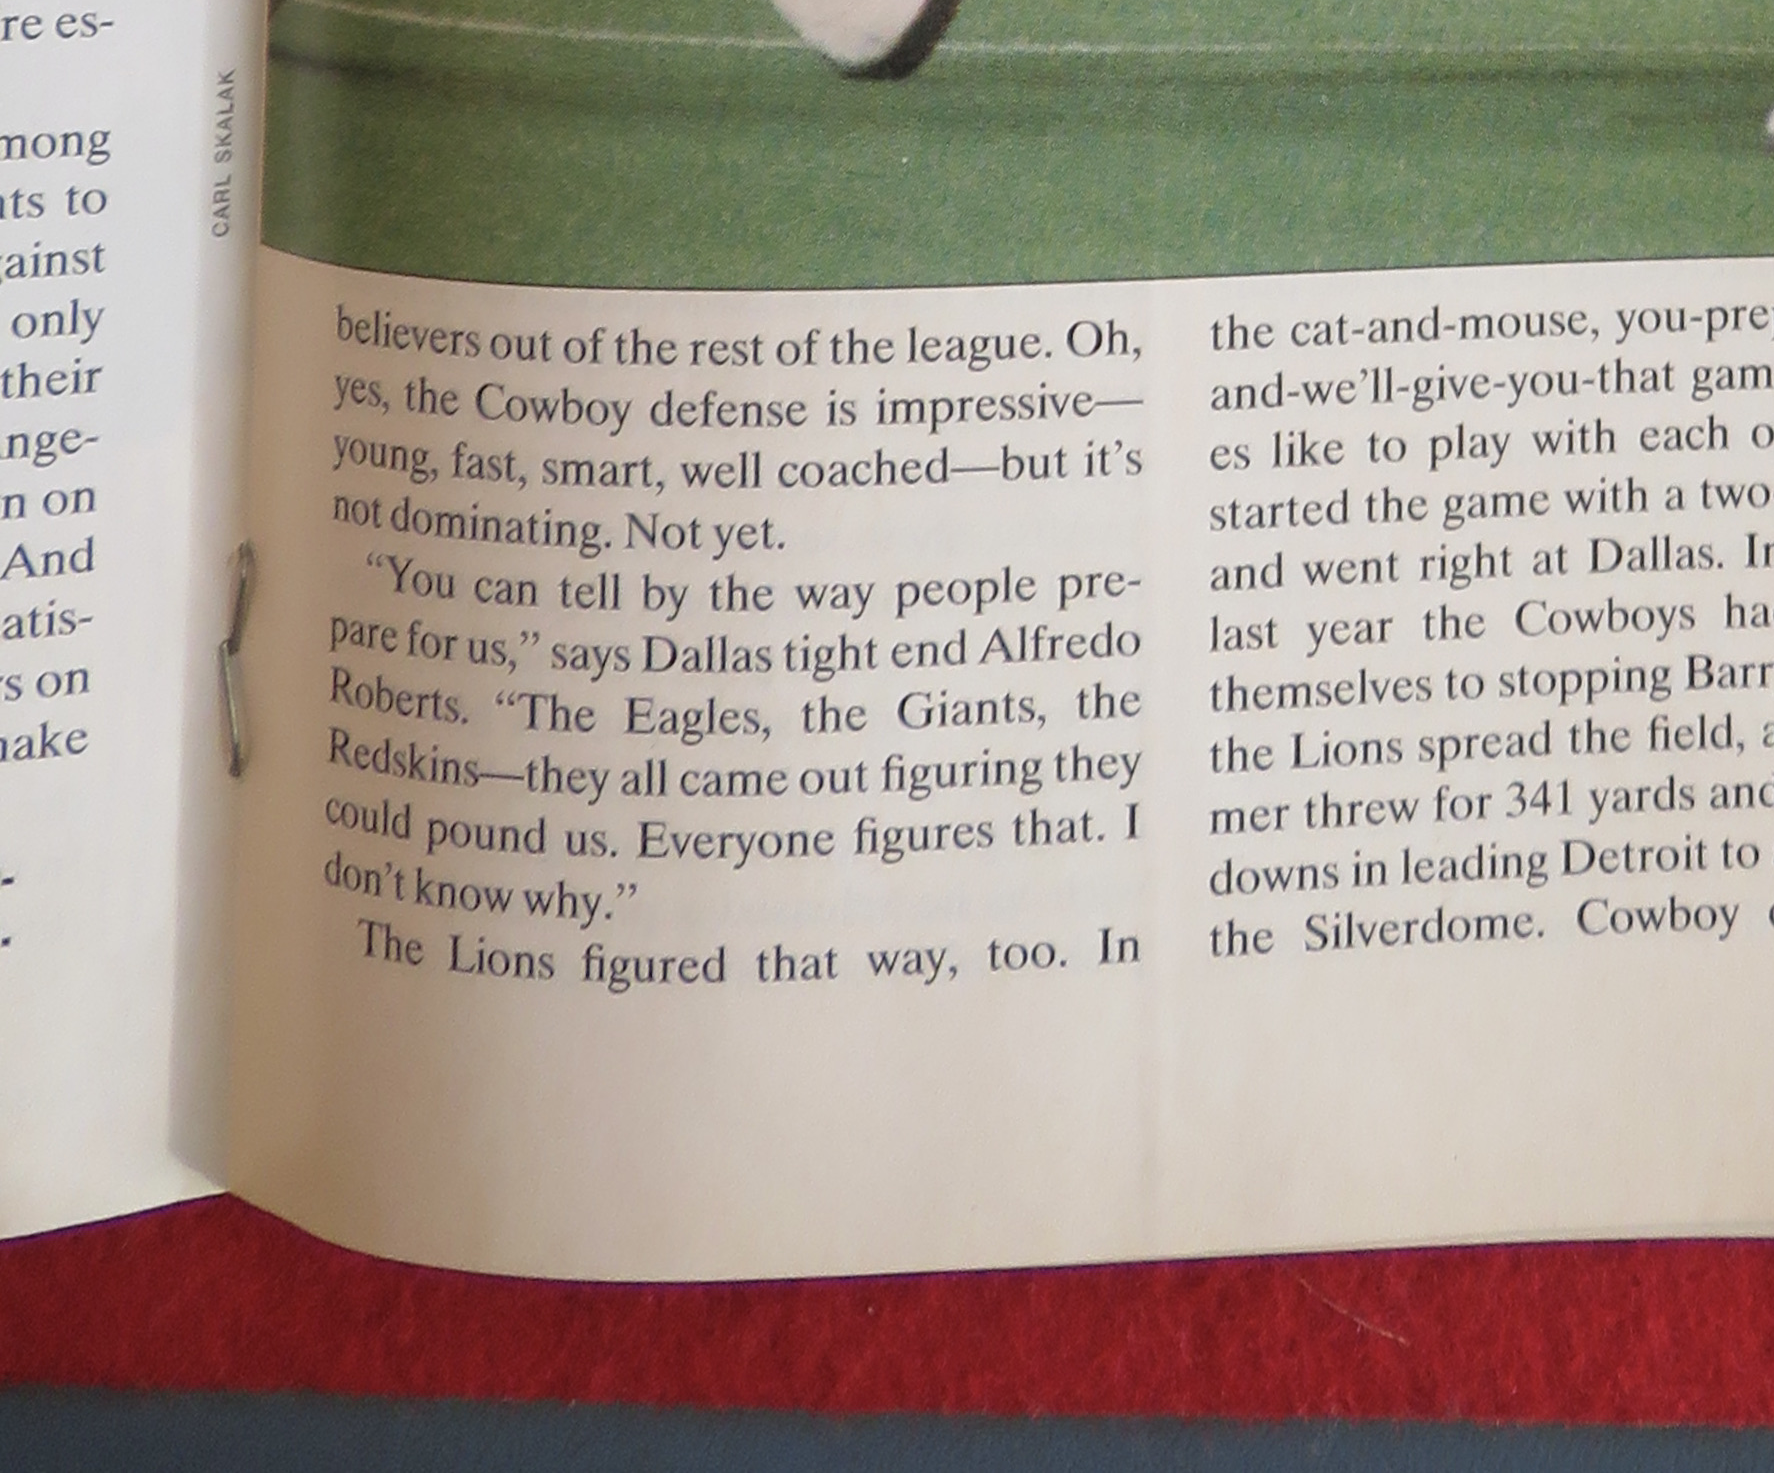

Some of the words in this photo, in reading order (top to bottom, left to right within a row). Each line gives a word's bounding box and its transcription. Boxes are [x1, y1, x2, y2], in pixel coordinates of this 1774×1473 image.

[214, 68, 237, 164] SKALAK
[211, 173, 232, 238] CARL
[11, 298, 105, 345] only
[336, 303, 482, 358] believers
[489, 330, 552, 363] out
[563, 327, 608, 364] of
[614, 326, 679, 366] the
[689, 334, 764, 367] rest
[776, 328, 821, 366] of
[829, 327, 895, 365] the
[907, 326, 1052, 372] league.
[1066, 318, 1142, 362] Oh,
[1210, 313, 1275, 351] the
[1291, 304, 1599, 347] cat-and-mouse,
[332, 435, 439, 485] young,
[451, 441, 528, 491] fast,
[542, 456, 665, 496] smart,
[680, 450, 762, 489] well
[1210, 487, 1350, 531] started
[1365, 486, 1428, 523] the
[1442, 491, 1550, 531] game
[1563, 476, 1648, 514] with
[1665, 485, 1686, 511] a
[474, 576, 539, 607] can
[558, 571, 621, 610] tell
[642, 573, 689, 622] by
[709, 571, 774, 612] the
[794, 582, 876, 620] way
[895, 565, 1037, 619] people
[1057, 572, 1141, 611] pre-
[1210, 614, 1278, 653] last
[1306, 617, 1393, 658] year
[1423, 603, 1486, 641] the
[1515, 596, 1695, 642] Cowboys
[36, 668, 90, 698] on
[329, 665, 469, 725] Roberts.
[623, 696, 771, 746] Eagles,
[801, 694, 867, 734] the
[897, 689, 1046, 730] Giants,
[1076, 681, 1142, 720] the
[1210, 734, 1274, 773] the
[1290, 730, 1403, 769] Lions
[1419, 719, 1552, 773] spread
[1568, 716, 1631, 755] the
[1647, 712, 1745, 757] field,
[357, 918, 424, 966] The
[448, 934, 555, 981] Lions
[581, 942, 727, 995] figured
[756, 943, 838, 983] that
[867, 947, 958, 986] way,
[987, 939, 1067, 971] too.
[1098, 927, 1140, 965] In
[1209, 918, 1274, 958] the
[1305, 905, 1544, 952] Silverdome.
[1577, 894, 1739, 941] Cowboy
